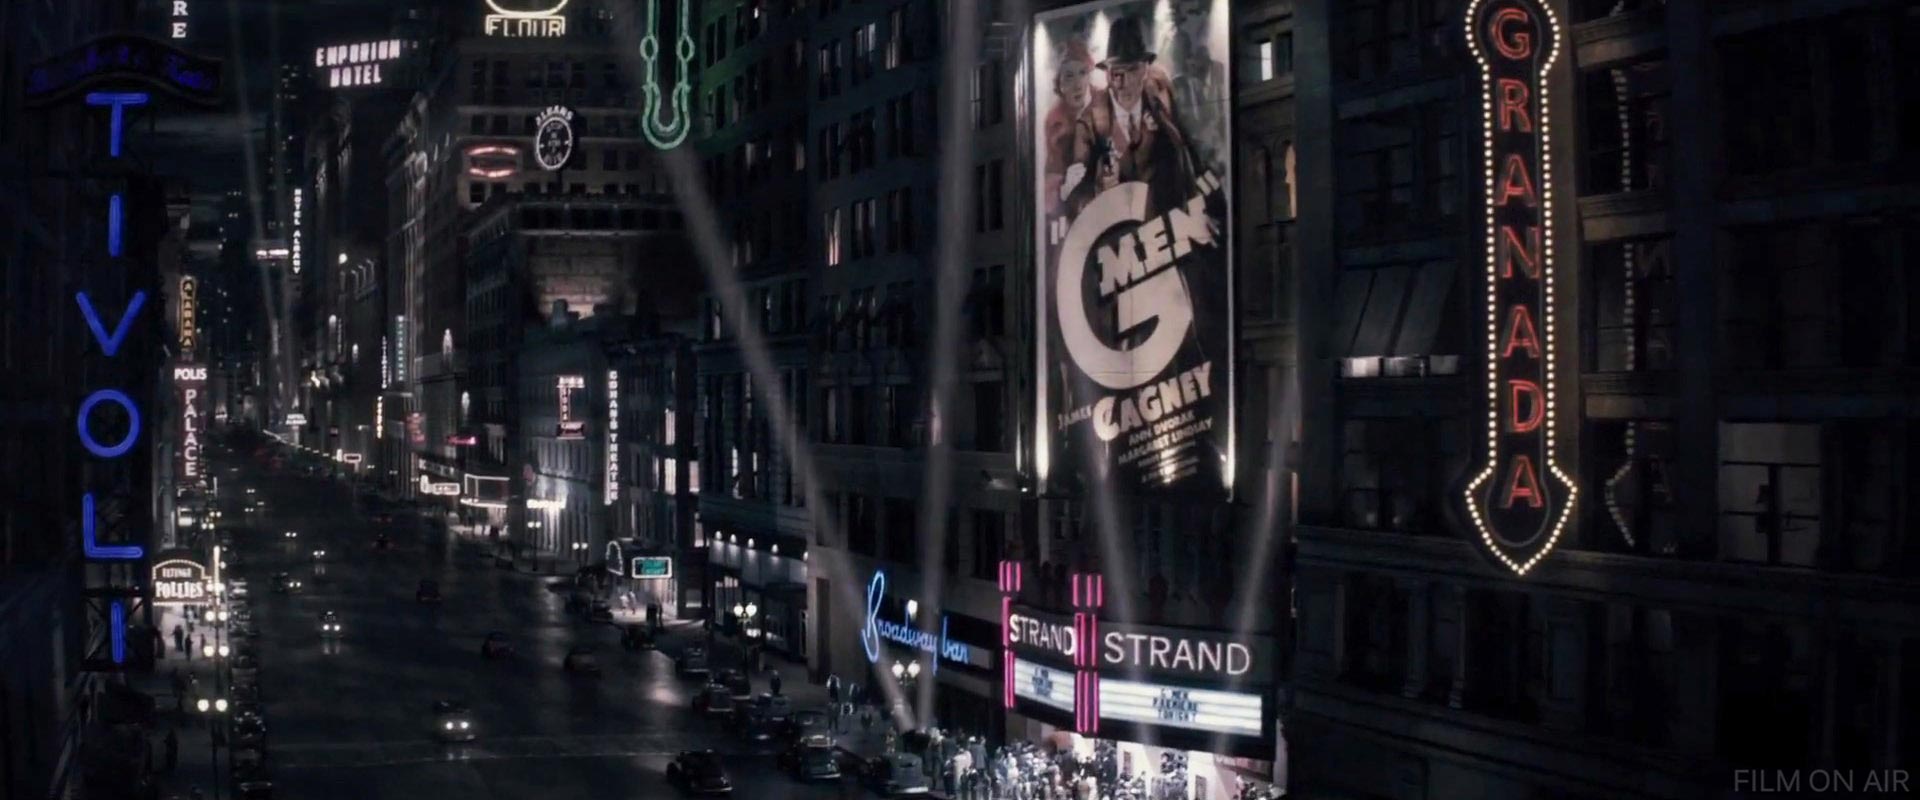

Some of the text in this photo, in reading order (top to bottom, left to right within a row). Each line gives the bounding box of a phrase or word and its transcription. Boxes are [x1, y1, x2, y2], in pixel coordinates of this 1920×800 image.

[315, 39, 401, 67] EMPORIUM
[330, 64, 382, 88] HOTEL
[293, 188, 302, 226] HOTEL
[1489, 8, 1544, 509] GRANADA
[76, 92, 149, 663] TIVOLI
[1093, 361, 1212, 441] CAGNEY
[184, 388, 198, 476] PALACE
[1117, 433, 1171, 465] MARGARET
[1170, 416, 1213, 444] LINDSAY
[1128, 409, 1195, 447] ANN DVORAK
[609, 433, 619, 501] THEATRE
[155, 581, 204, 598] FOLLIES
[861, 569, 970, 677] Broadway bar
[1009, 613, 1076, 657] STRAND
[1103, 631, 1251, 676] STRAND
